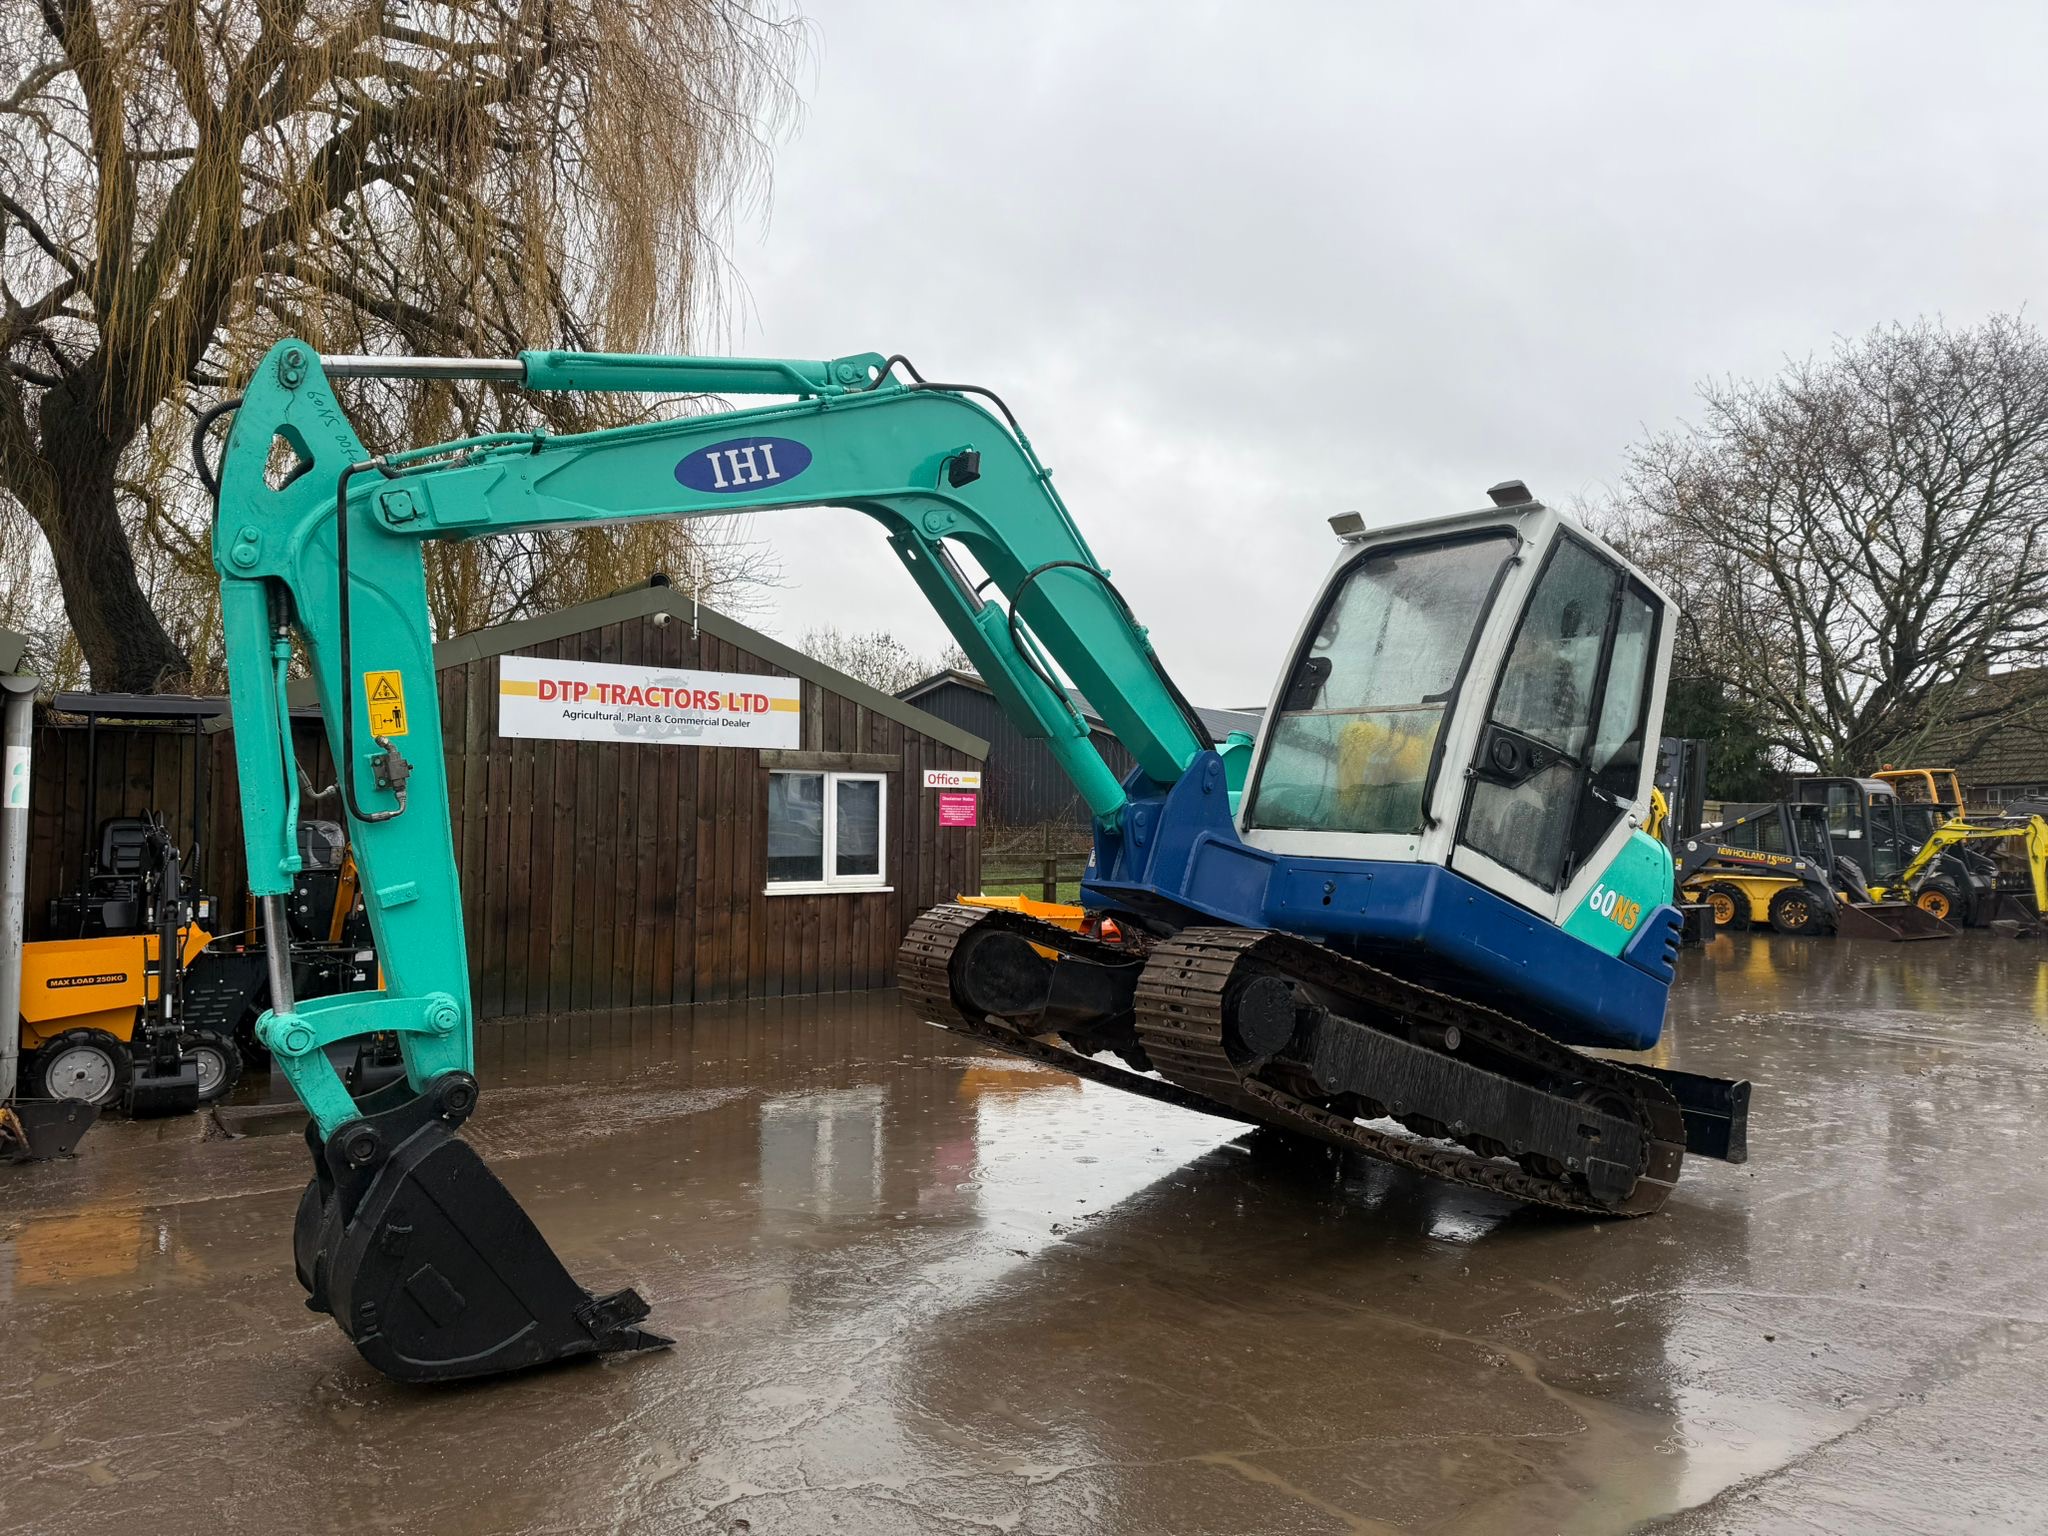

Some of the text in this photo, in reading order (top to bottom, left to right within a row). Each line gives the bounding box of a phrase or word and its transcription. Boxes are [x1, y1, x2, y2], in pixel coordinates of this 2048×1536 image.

[706, 443, 780, 489] IHI
[538, 679, 769, 713] DTP TRACTORS LTD
[562, 709, 751, 728] Agricultural, Plant & Commercial Dealer
[928, 773, 960, 785] Office
[1733, 849, 1766, 861] HOLLAND
[1589, 883, 1640, 930] 60NS
[50, 975, 123, 987] MAX LOAD 250KG
